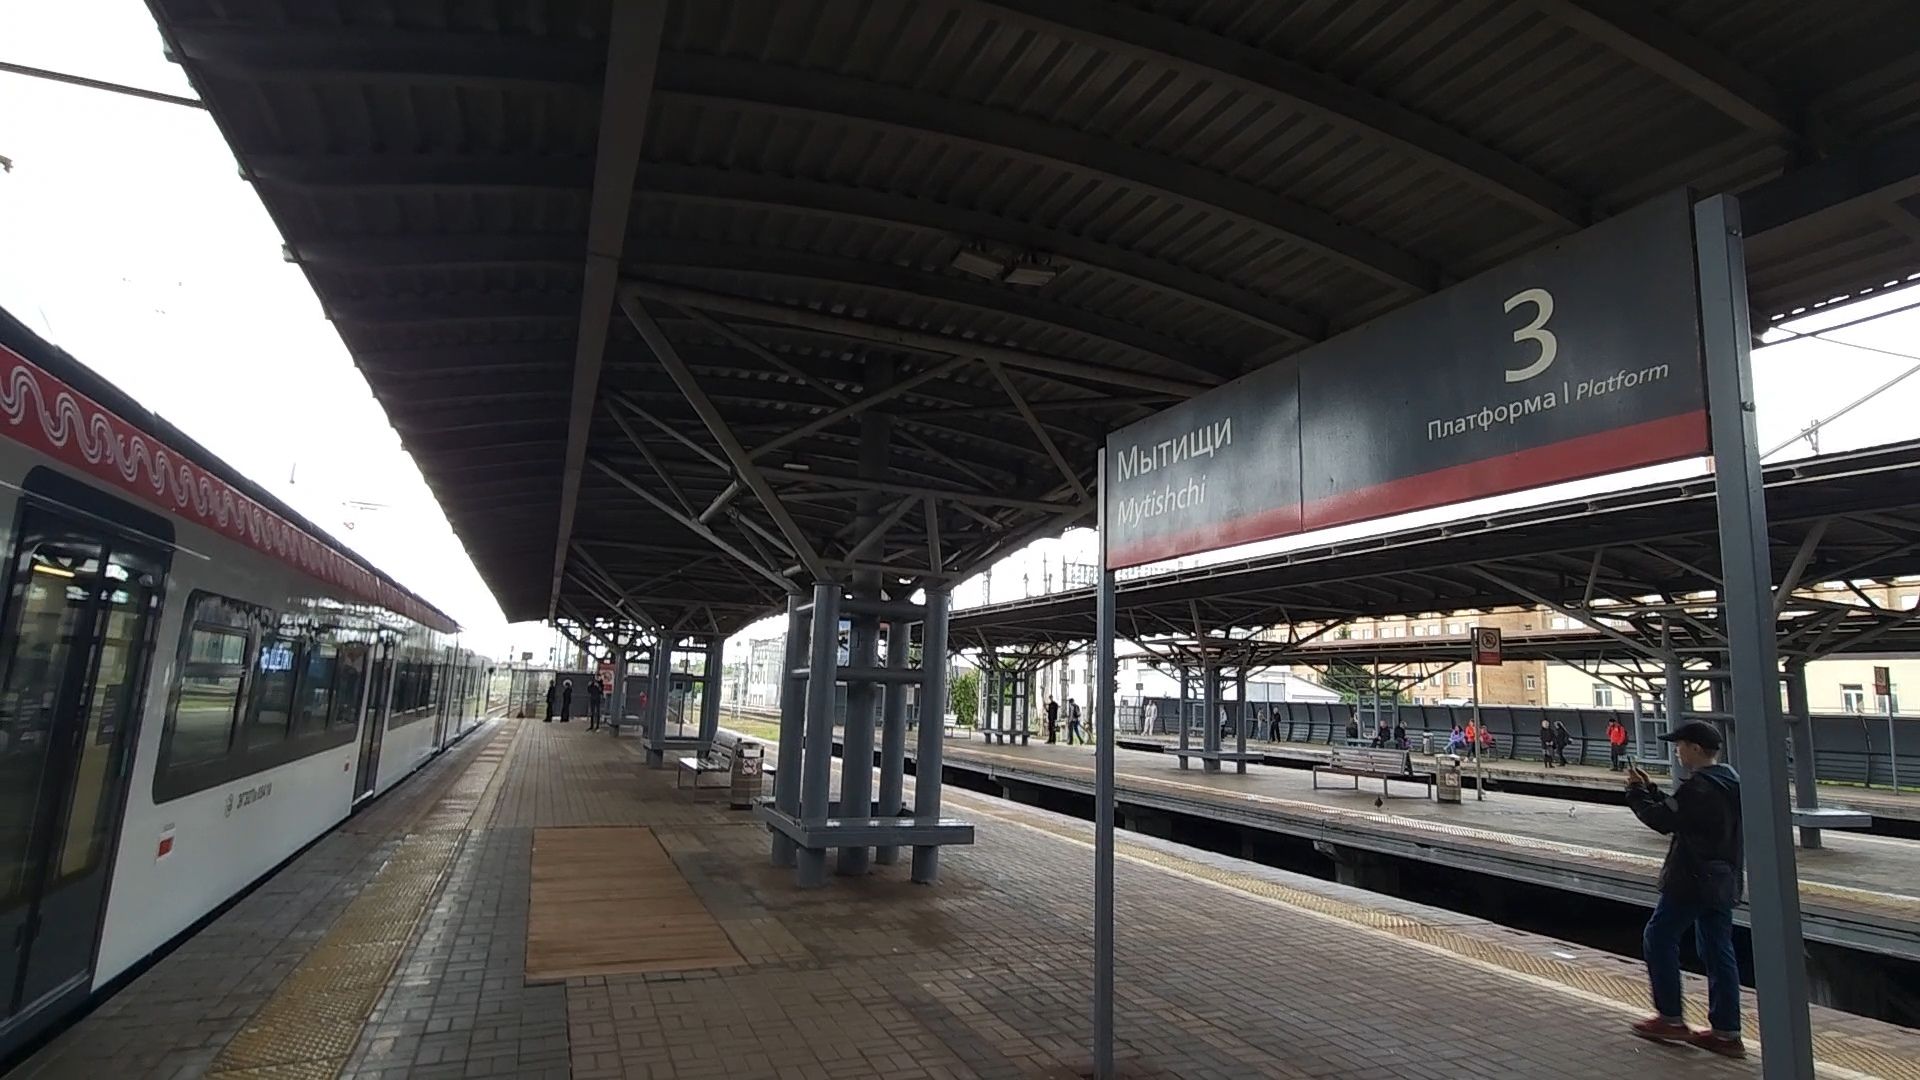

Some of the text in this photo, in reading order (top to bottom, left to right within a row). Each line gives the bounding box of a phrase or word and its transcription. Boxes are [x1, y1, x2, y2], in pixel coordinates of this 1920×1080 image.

[1503, 288, 1558, 383] 3
[1427, 391, 1557, 440] Платформа
[1576, 363, 1669, 400] Platform
[1117, 417, 1232, 483] Мытищи
[1117, 474, 1206, 529] Mytishchi
